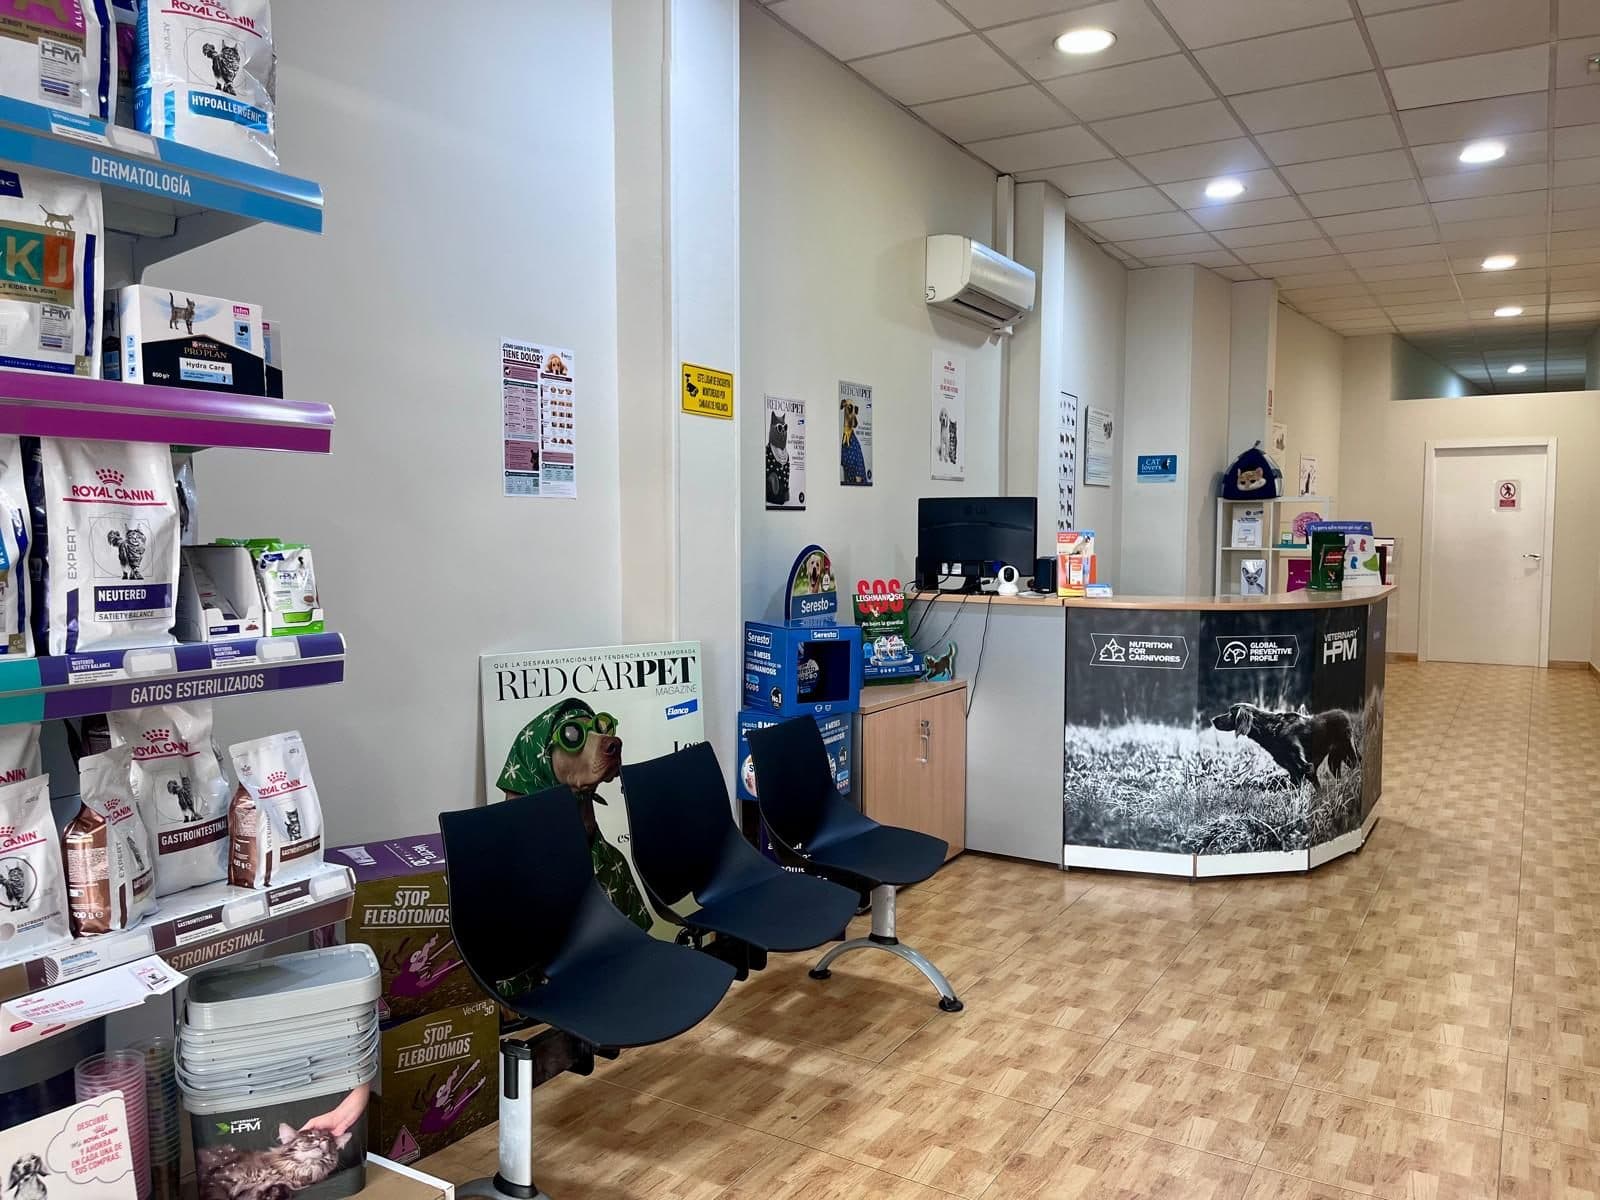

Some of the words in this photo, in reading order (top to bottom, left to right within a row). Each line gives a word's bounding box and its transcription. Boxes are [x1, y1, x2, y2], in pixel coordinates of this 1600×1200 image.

[40, 44, 80, 64] HPM
[191, 94, 262, 124] HYPOALLERGENIC
[91, 155, 192, 197] DERMATOLOGÍA
[48, 244, 67, 283] J
[42, 306, 71, 320] HPM
[184, 347, 202, 355] PRO
[204, 349, 227, 359] PLAN
[502, 349, 519, 360] TIENE
[520, 352, 544, 364] DOLOR?
[186, 361, 207, 370] Hydra
[1145, 458, 1161, 466] CAT
[72, 484, 113, 499] ROYAL
[114, 488, 155, 501] CANIN
[66, 526, 78, 580] EXPERT
[98, 588, 147, 602] NEUTERED
[857, 578, 904, 614] SOS
[801, 599, 829, 614] Seresto
[747, 631, 770, 646] Seresto
[813, 631, 837, 639] Seresto
[1323, 630, 1358, 642] VETERINARY
[1128, 641, 1173, 650] NUTRITION
[1250, 641, 1278, 649] GLOBAL
[1250, 647, 1293, 655] PREVENTIVE
[1323, 638, 1358, 665] HPM
[523, 656, 587, 667] DESPARASITACIÓN
[604, 652, 641, 661] TENDENCIA
[642, 650, 658, 658] ESTA
[660, 648, 697, 657] TEMPORADA
[1128, 654, 1181, 663] CARNIVORES
[1250, 654, 1279, 662] PROFILE
[131, 684, 173, 704] GATOS
[176, 673, 264, 699] ESTERILIZADOS
[655, 684, 697, 697] MAGAZINE
[667, 706, 689, 716] Elanco
[3, 831, 38, 848] CANIN
[161, 820, 228, 846] GASTROINTESTINAL
[394, 889, 431, 907] STOP
[177, 913, 214, 928] GASTROINTESTINAL
[462, 1001, 487, 1016] Vectra
[484, 1004, 495, 1017] 3D
[423, 1024, 453, 1045] STOP
[77, 1113, 109, 1131] DESCUBRE
[230, 1121, 261, 1134] HPM
[86, 1138, 112, 1153] AHORRA
[71, 1160, 80, 1168] EN
[81, 1152, 99, 1164] CADA
[100, 1147, 113, 1157] UNA
[114, 1142, 122, 1151] DE
[75, 1165, 88, 1175] TUS
[88, 1152, 120, 1170] COMPRAS
